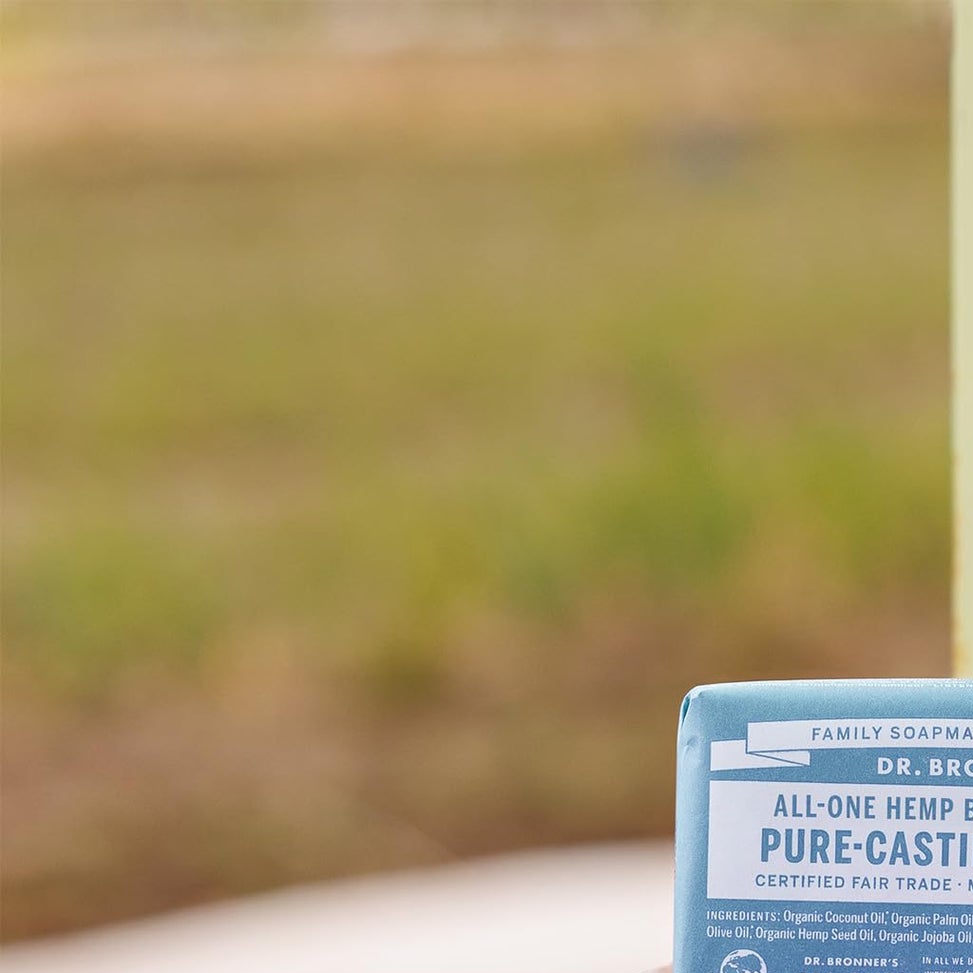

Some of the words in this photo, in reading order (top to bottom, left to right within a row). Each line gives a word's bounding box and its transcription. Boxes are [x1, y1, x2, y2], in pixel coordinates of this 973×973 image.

[812, 726, 882, 741] FAMILY
[877, 757, 921, 776] DR.
[773, 794, 876, 820] ALL-ONE
[886, 796, 954, 821] HEMP
[755, 874, 845, 888] CERTIFIED
[852, 876, 889, 889] FAIR
[896, 877, 952, 891] TRADE
[706, 911, 781, 922] INGREDIENTS:
[783, 910, 824, 925] Organic
[825, 911, 868, 924] Coconut
[891, 912, 931, 928] Organic
[933, 914, 959, 926] Palm
[706, 926, 733, 938] Olive
[756, 927, 796, 942] Organic
[798, 928, 828, 942] Hemp
[831, 929, 857, 941] Seed
[859, 929, 877, 942] Oil,
[879, 929, 919, 944] Organic
[921, 931, 955, 945] Jojoba
[804, 957, 825, 966] DR.
[827, 957, 899, 967] BRONNER'S
[934, 957, 950, 965] ALL
[952, 957, 964, 966] WE
